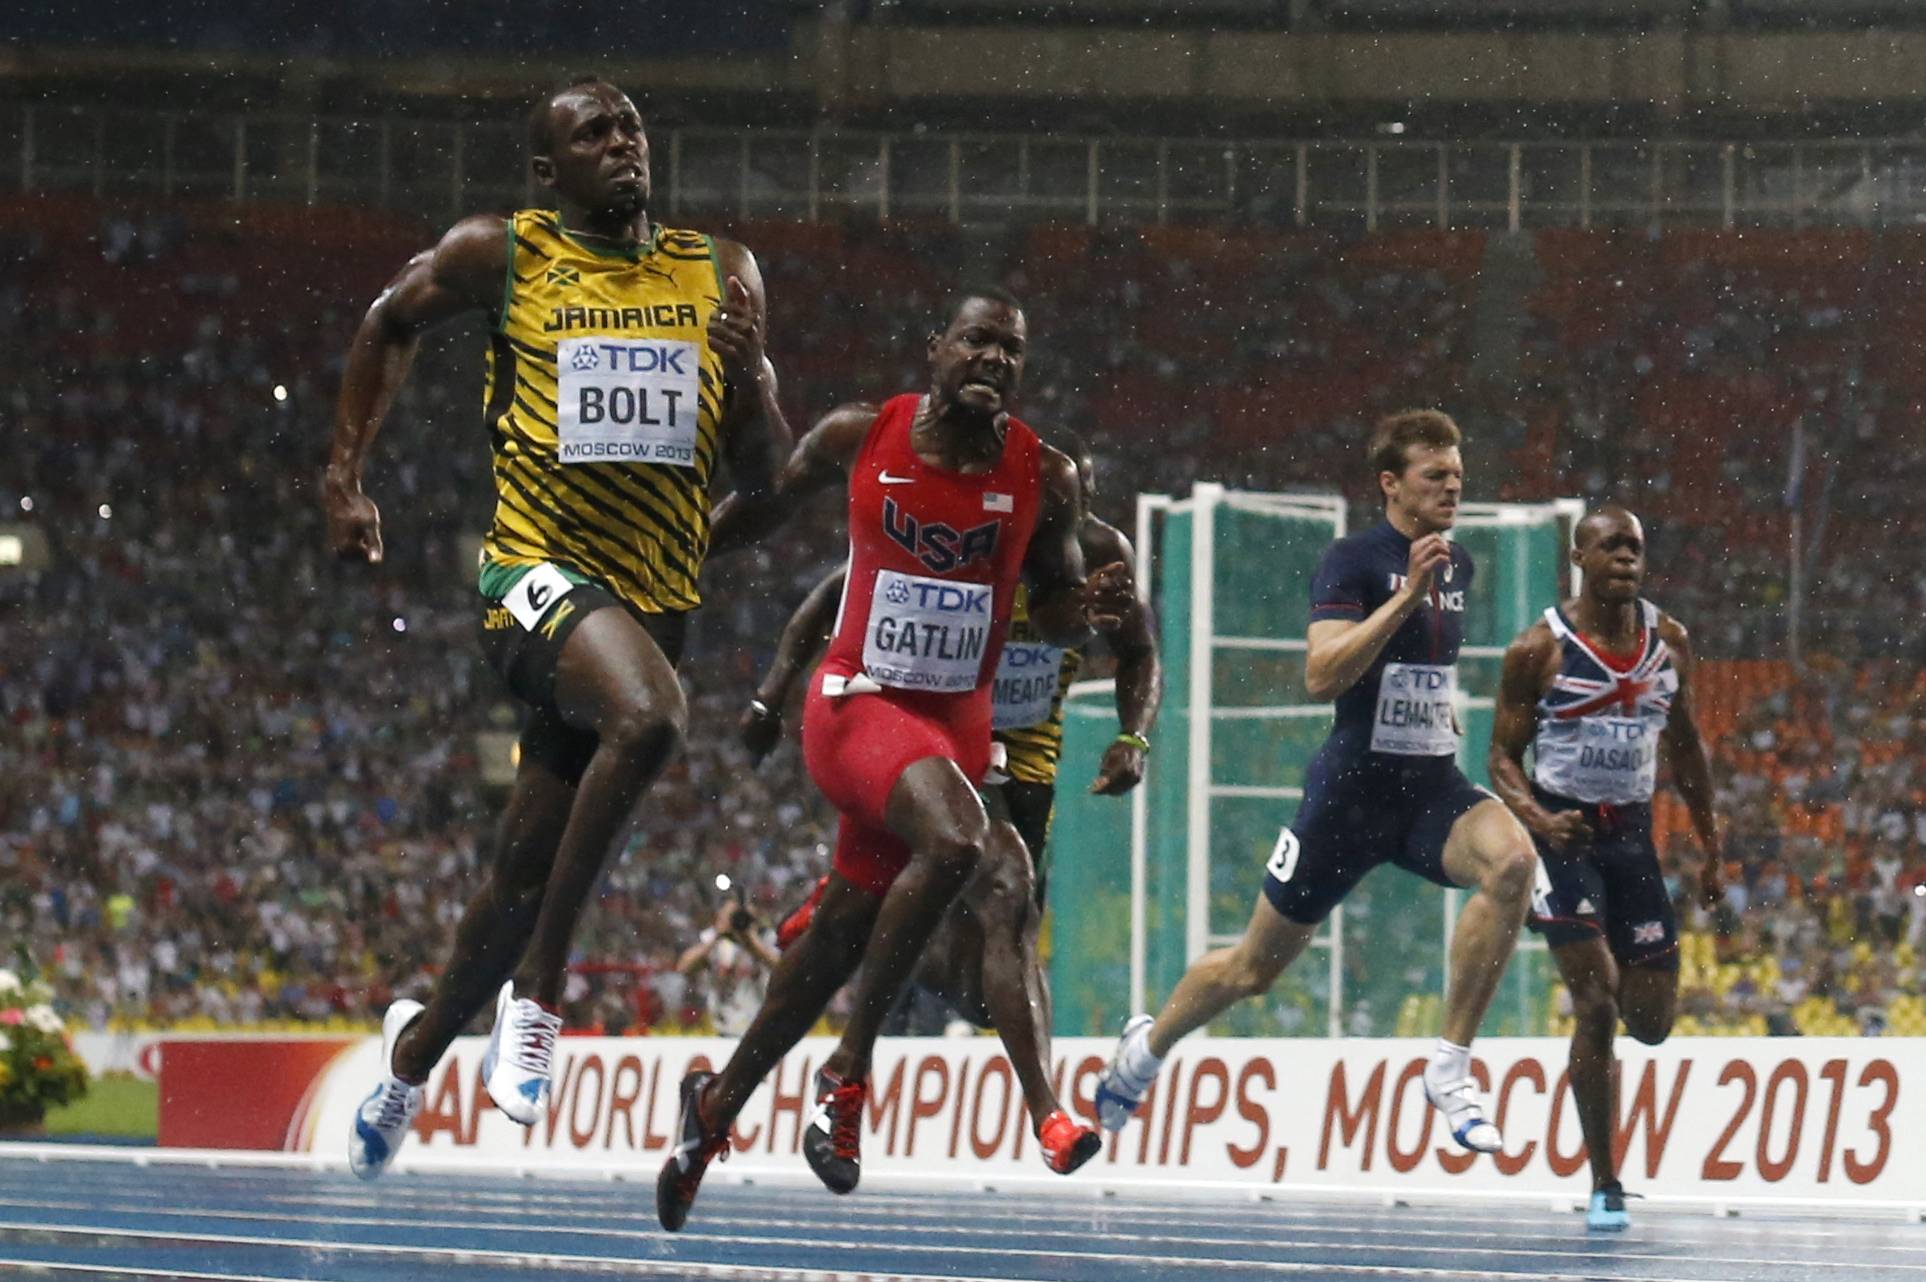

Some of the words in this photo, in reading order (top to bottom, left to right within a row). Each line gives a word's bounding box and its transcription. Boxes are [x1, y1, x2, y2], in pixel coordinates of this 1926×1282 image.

[544, 304, 698, 332] JAMAICA
[599, 344, 686, 375] TDK
[578, 387, 682, 427] BOLT
[564, 442, 649, 457] MOSCOW
[655, 443, 692, 462] 2013
[882, 496, 1001, 574] USA
[526, 580, 553, 612] 6
[912, 582, 990, 613] TDK
[876, 617, 984, 660] GATLIN
[1004, 646, 1051, 668] DK
[867, 664, 943, 687] MOSCOW
[1275, 838, 1290, 869] 3
[523, 1054, 712, 1151] WORL
[1701, 1057, 1901, 1185] 2013
